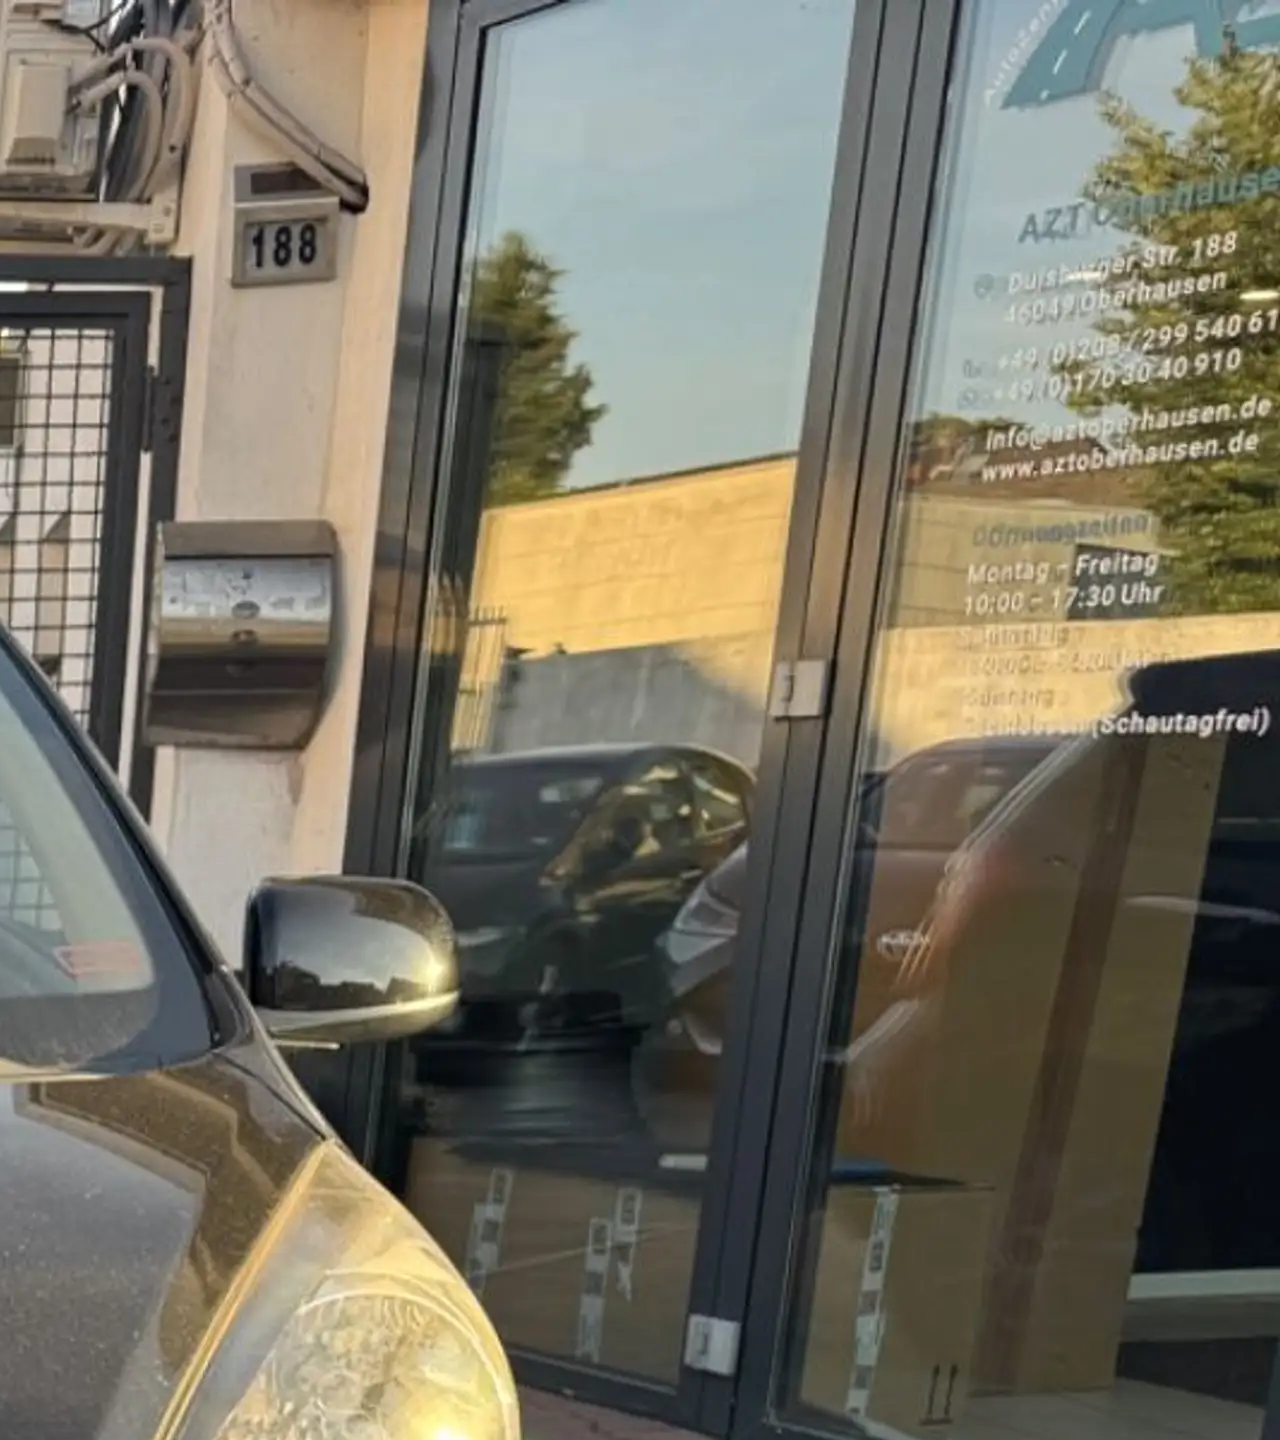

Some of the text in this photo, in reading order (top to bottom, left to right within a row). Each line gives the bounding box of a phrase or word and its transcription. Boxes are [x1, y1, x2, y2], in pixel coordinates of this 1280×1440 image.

[1017, 202, 1086, 244] AZT
[252, 222, 317, 268] 188
[1191, 231, 1238, 258] 188
[1143, 322, 1189, 350] 299
[1194, 314, 1242, 340] 540
[1247, 308, 1279, 334] 61
[1157, 356, 1188, 380] 40
[1193, 347, 1242, 373] 910
[981, 429, 1260, 483] www.aztoberhausen.de
[967, 562, 1051, 585] Montag
[1075, 551, 1159, 577] Freitag
[1051, 583, 1116, 610] 17:30
[1121, 581, 1166, 604] Uhr
